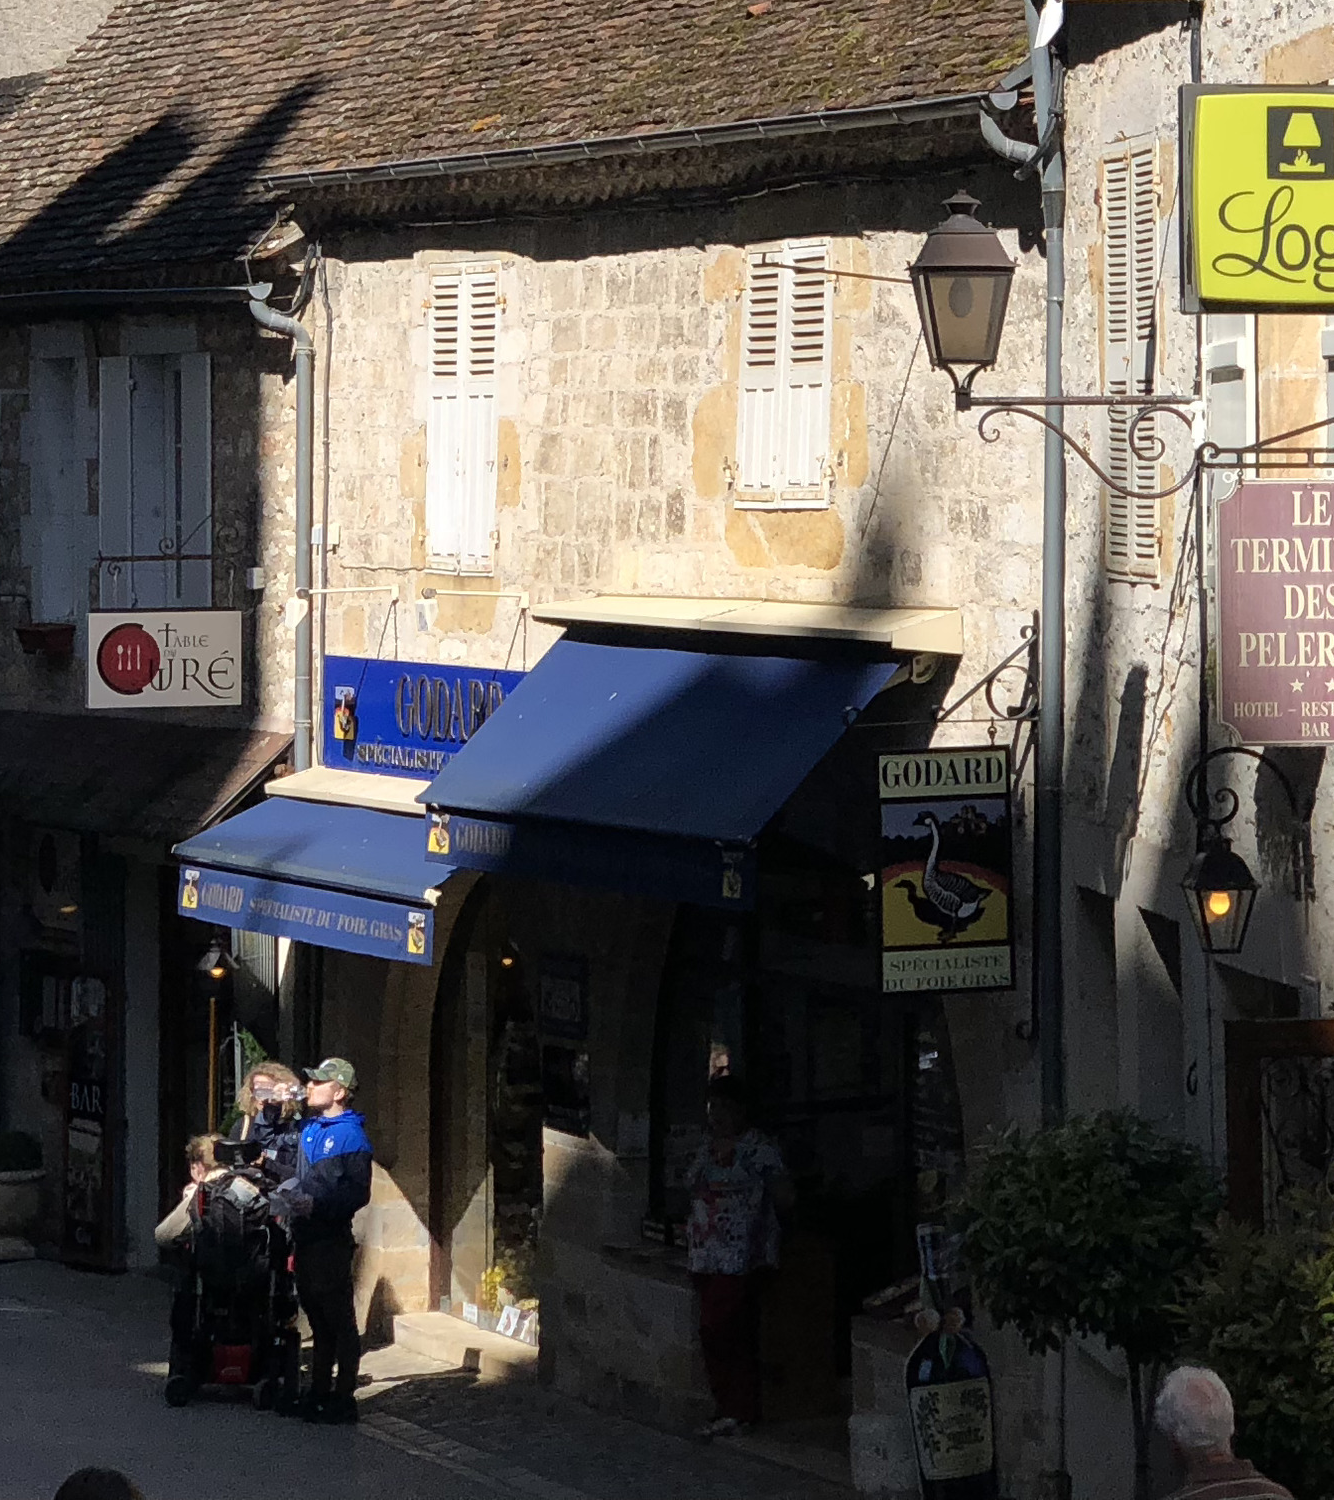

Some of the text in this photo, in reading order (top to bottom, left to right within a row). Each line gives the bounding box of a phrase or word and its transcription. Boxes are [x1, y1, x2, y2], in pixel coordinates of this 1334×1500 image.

[1292, 490, 1333, 526] LE
[1233, 701, 1282, 718] HOTEL
[1300, 721, 1331, 737] BAR
[882, 756, 1004, 788] GODARD
